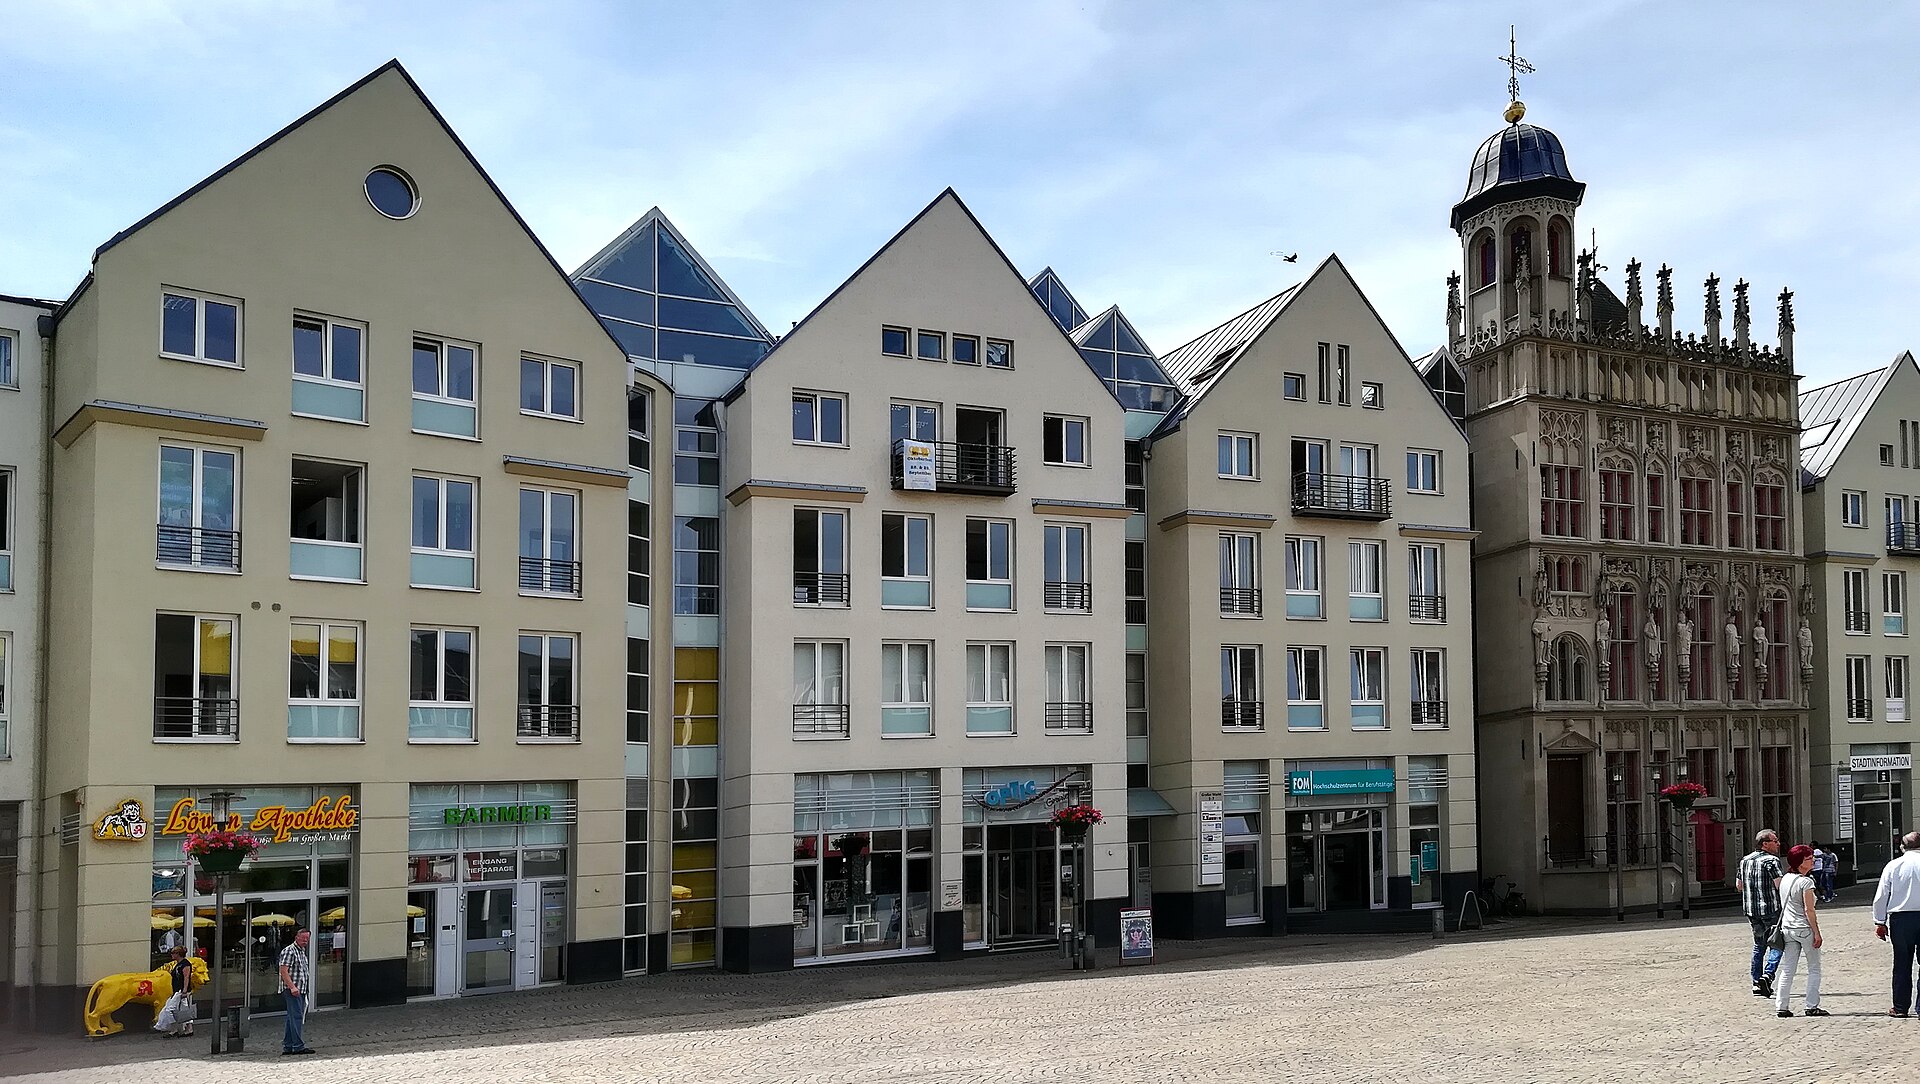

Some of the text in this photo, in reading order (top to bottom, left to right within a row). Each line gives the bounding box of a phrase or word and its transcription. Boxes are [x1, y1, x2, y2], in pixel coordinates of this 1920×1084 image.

[1851, 756, 1909, 768] STADTINFORMATION
[1293, 778, 1310, 790] FOM
[984, 780, 1037, 806] OPTIC
[162, 796, 356, 843] Löwn Apotheke
[443, 804, 551, 825] BARMER
[300, 832, 326, 846] Großen
[328, 829, 352, 840] Markt
[472, 858, 508, 866] EINGANG
[466, 866, 514, 874] TIEFGARAGE
